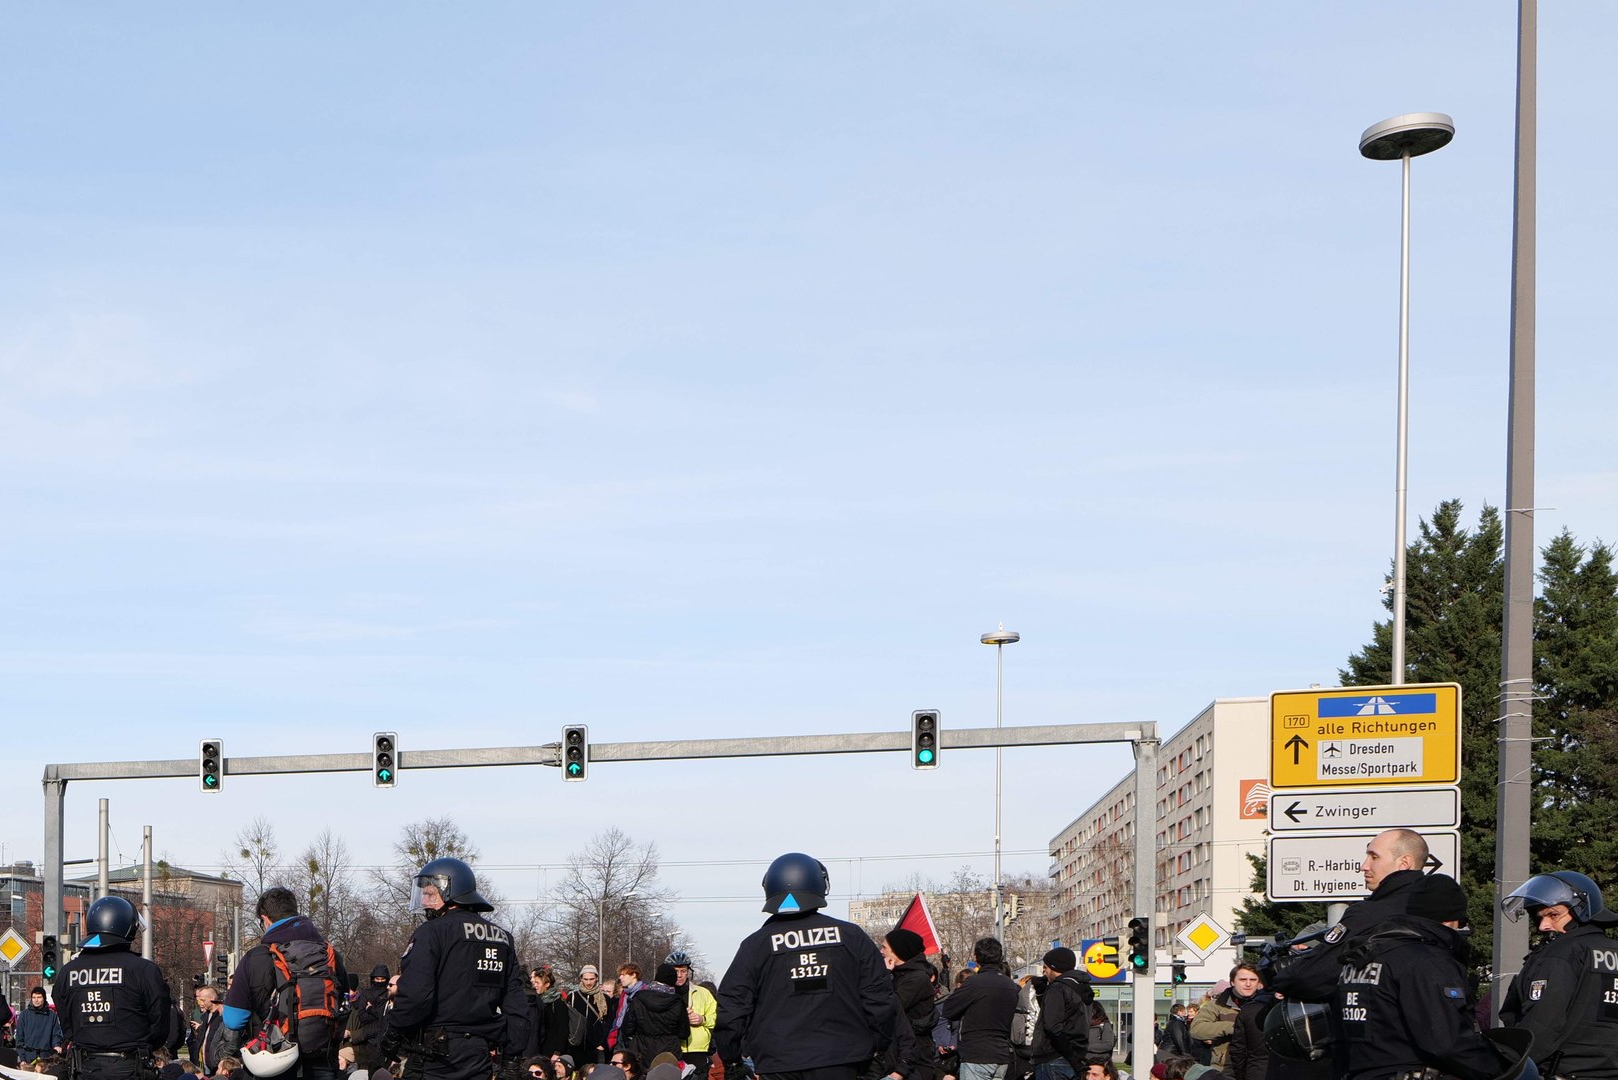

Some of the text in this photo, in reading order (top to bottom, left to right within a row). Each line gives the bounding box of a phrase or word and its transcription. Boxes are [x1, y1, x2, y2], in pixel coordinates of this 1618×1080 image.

[1288, 717, 1306, 727] 170
[1317, 721, 1437, 735] alle Richtungen
[1349, 742, 1395, 755] Dresden
[1322, 761, 1418, 777] Messe/Sportpark
[1315, 805, 1378, 820] Zwinger
[1293, 880, 1308, 892] Dt.
[771, 926, 841, 952] POLIZEI
[485, 947, 498, 959] BE
[800, 953, 818, 966] BE
[476, 959, 503, 972] 13129
[1593, 949, 1618, 971] PO
[69, 967, 123, 987] POLIZEI
[790, 964, 829, 979] 13127
[87, 991, 102, 1002] BE
[1346, 991, 1359, 1006] BE
[81, 1002, 111, 1013] 13120
